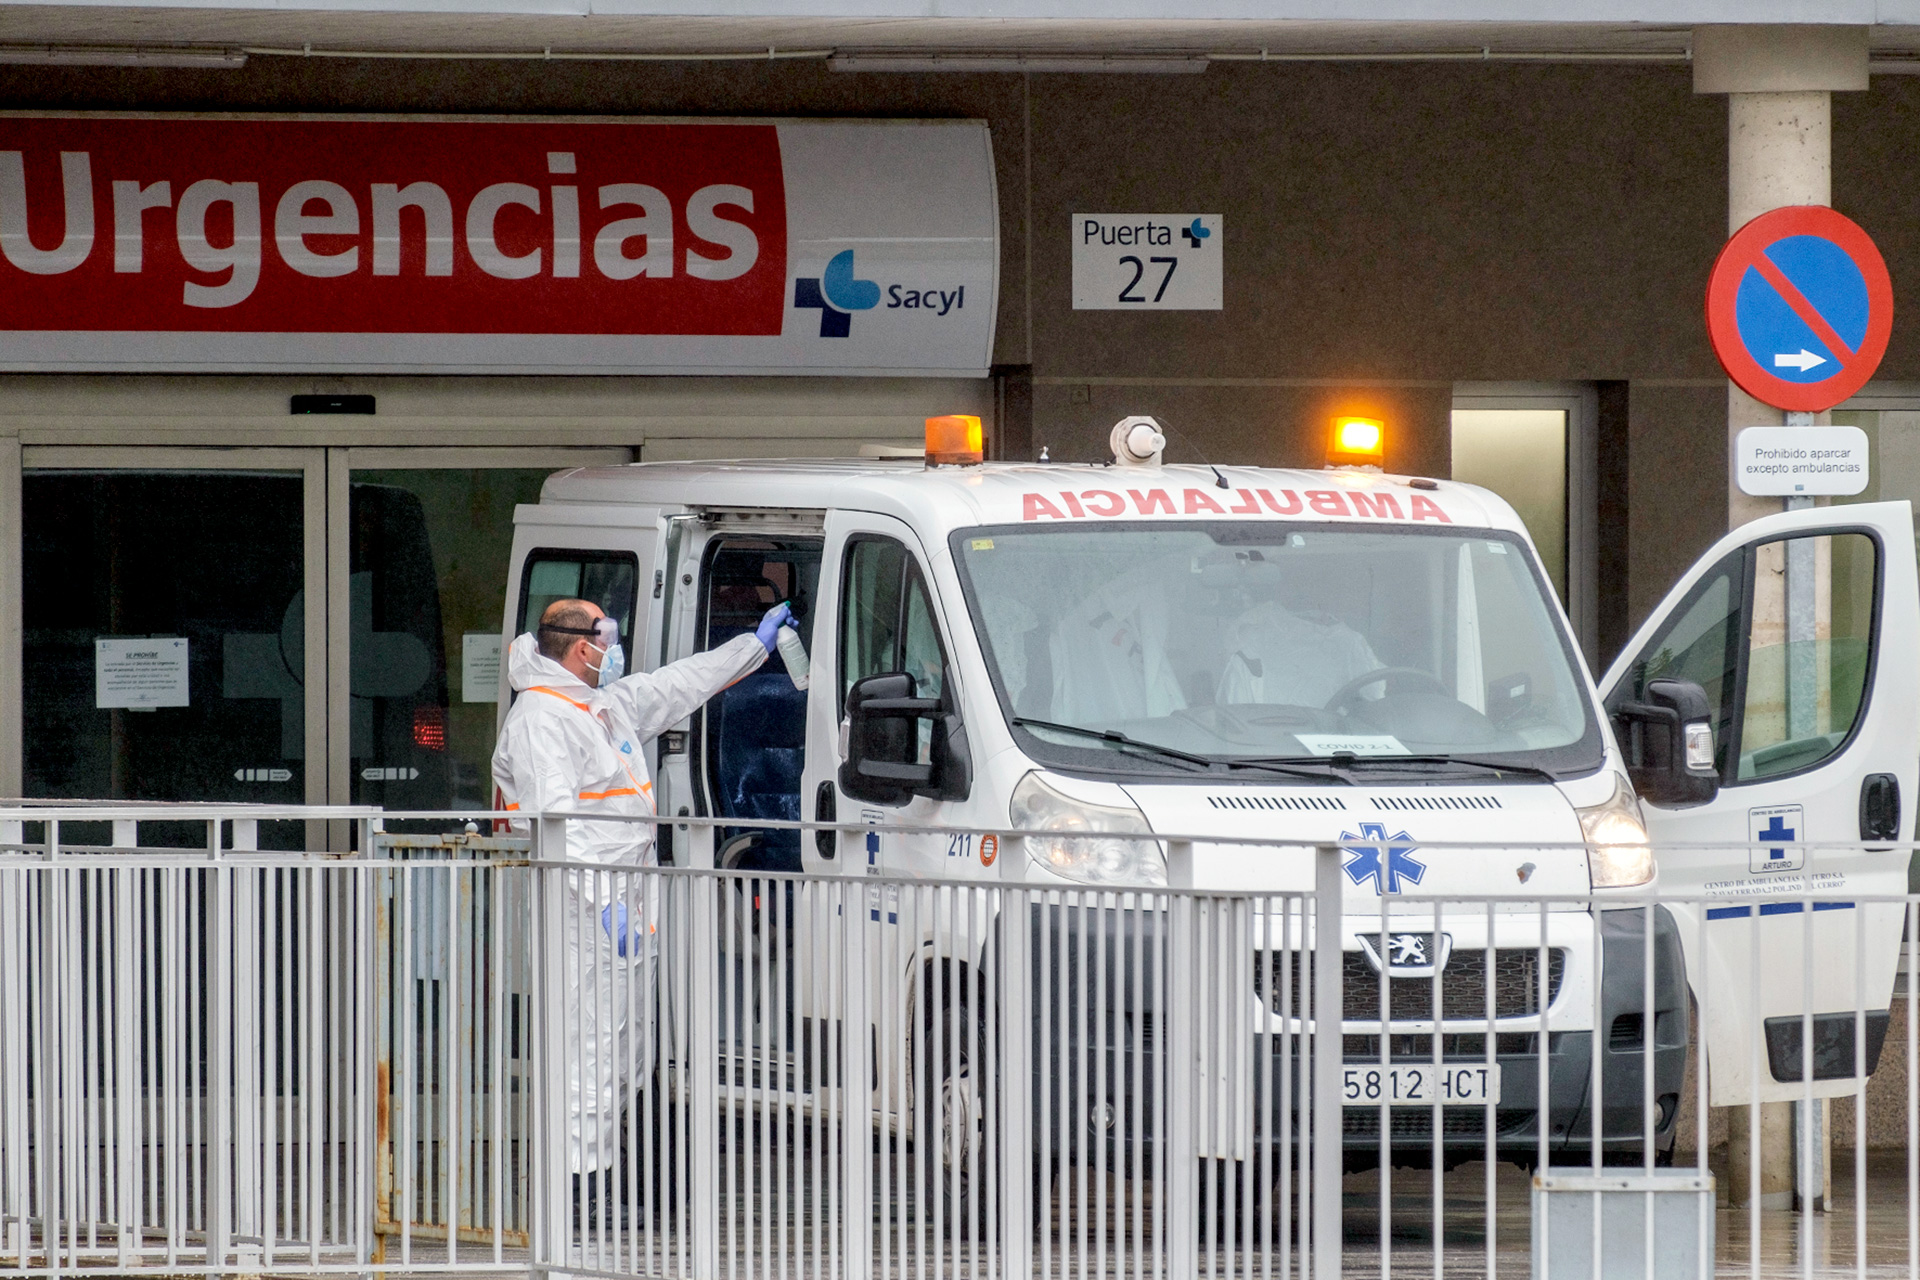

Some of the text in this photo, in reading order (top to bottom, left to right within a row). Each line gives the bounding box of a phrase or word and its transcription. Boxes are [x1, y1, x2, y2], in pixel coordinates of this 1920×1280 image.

[0, 150, 760, 308] Urgencias
[1084, 219, 1171, 246] Puerta
[1118, 255, 1178, 303] 27
[886, 284, 965, 316] Sacyl
[1755, 447, 1851, 460] Prohibido aparcar
[1746, 463, 1861, 475] excepto ambulancias
[948, 833, 972, 857] 211
[1762, 861, 1792, 870] ARTURO
[1704, 880, 1735, 889] CENTRO
[1748, 876, 1800, 885] AMBULANCIAS
[1344, 1070, 1422, 1099] 5812
